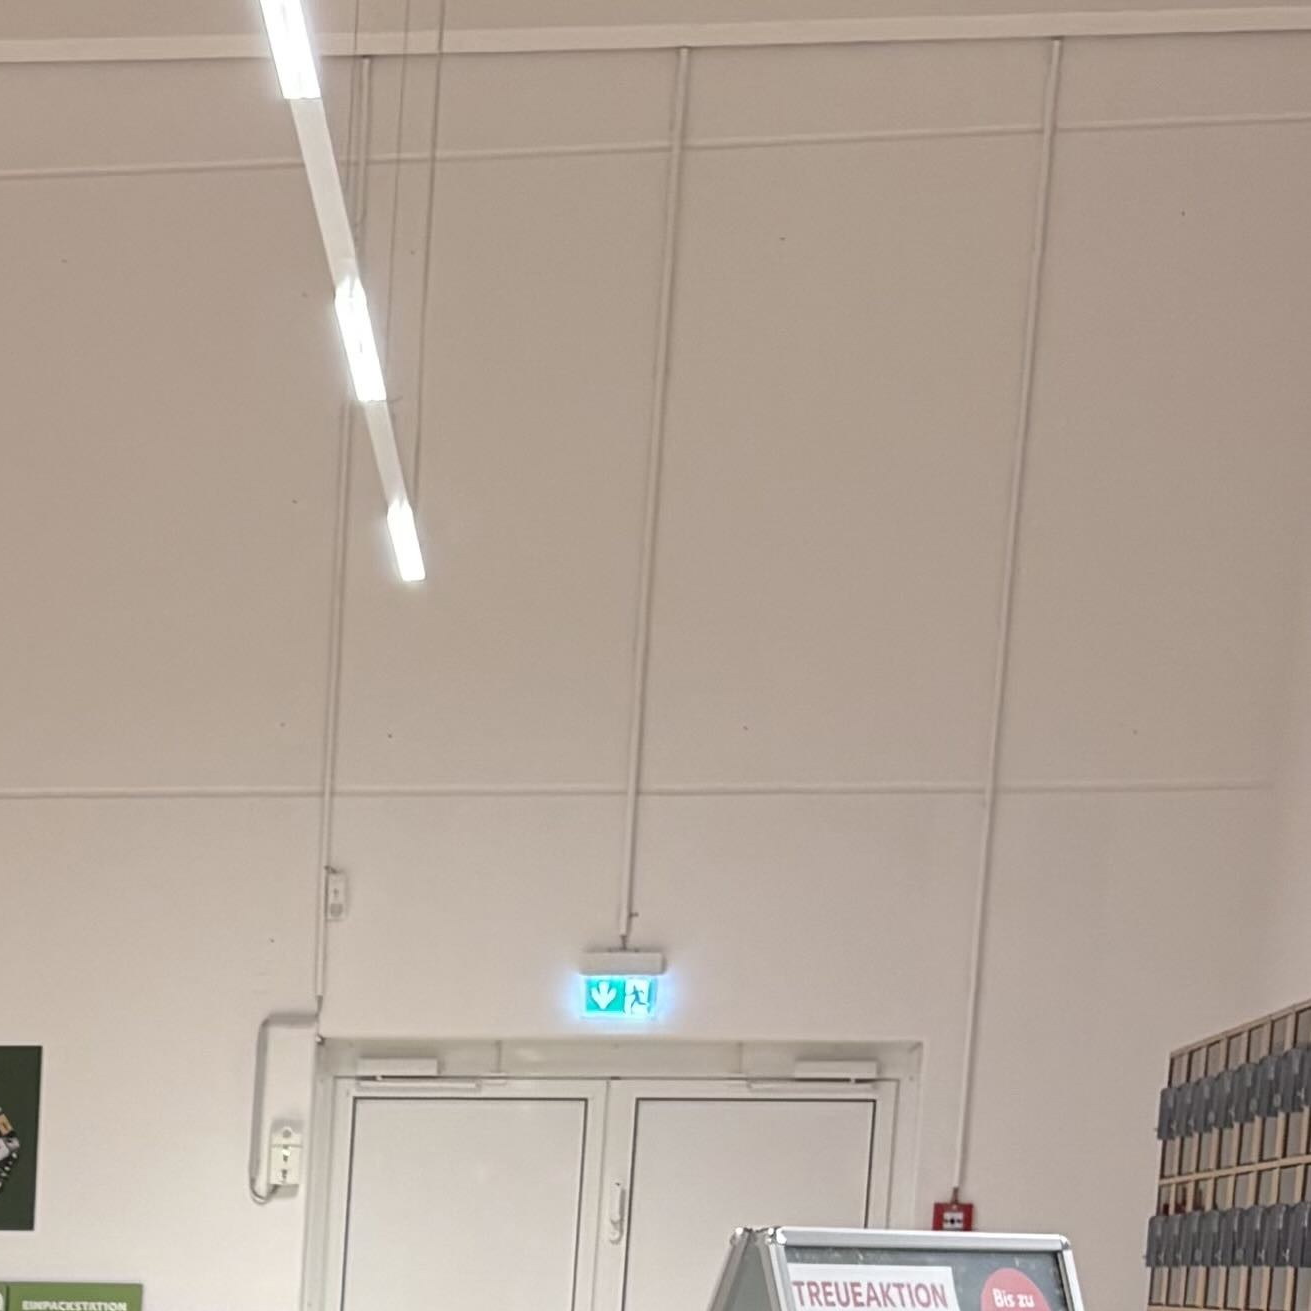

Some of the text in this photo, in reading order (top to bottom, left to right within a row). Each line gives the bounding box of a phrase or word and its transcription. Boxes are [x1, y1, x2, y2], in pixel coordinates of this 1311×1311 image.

[792, 1280, 949, 1309] TREUEAKTION
[992, 1287, 1035, 1308] Bis zu
